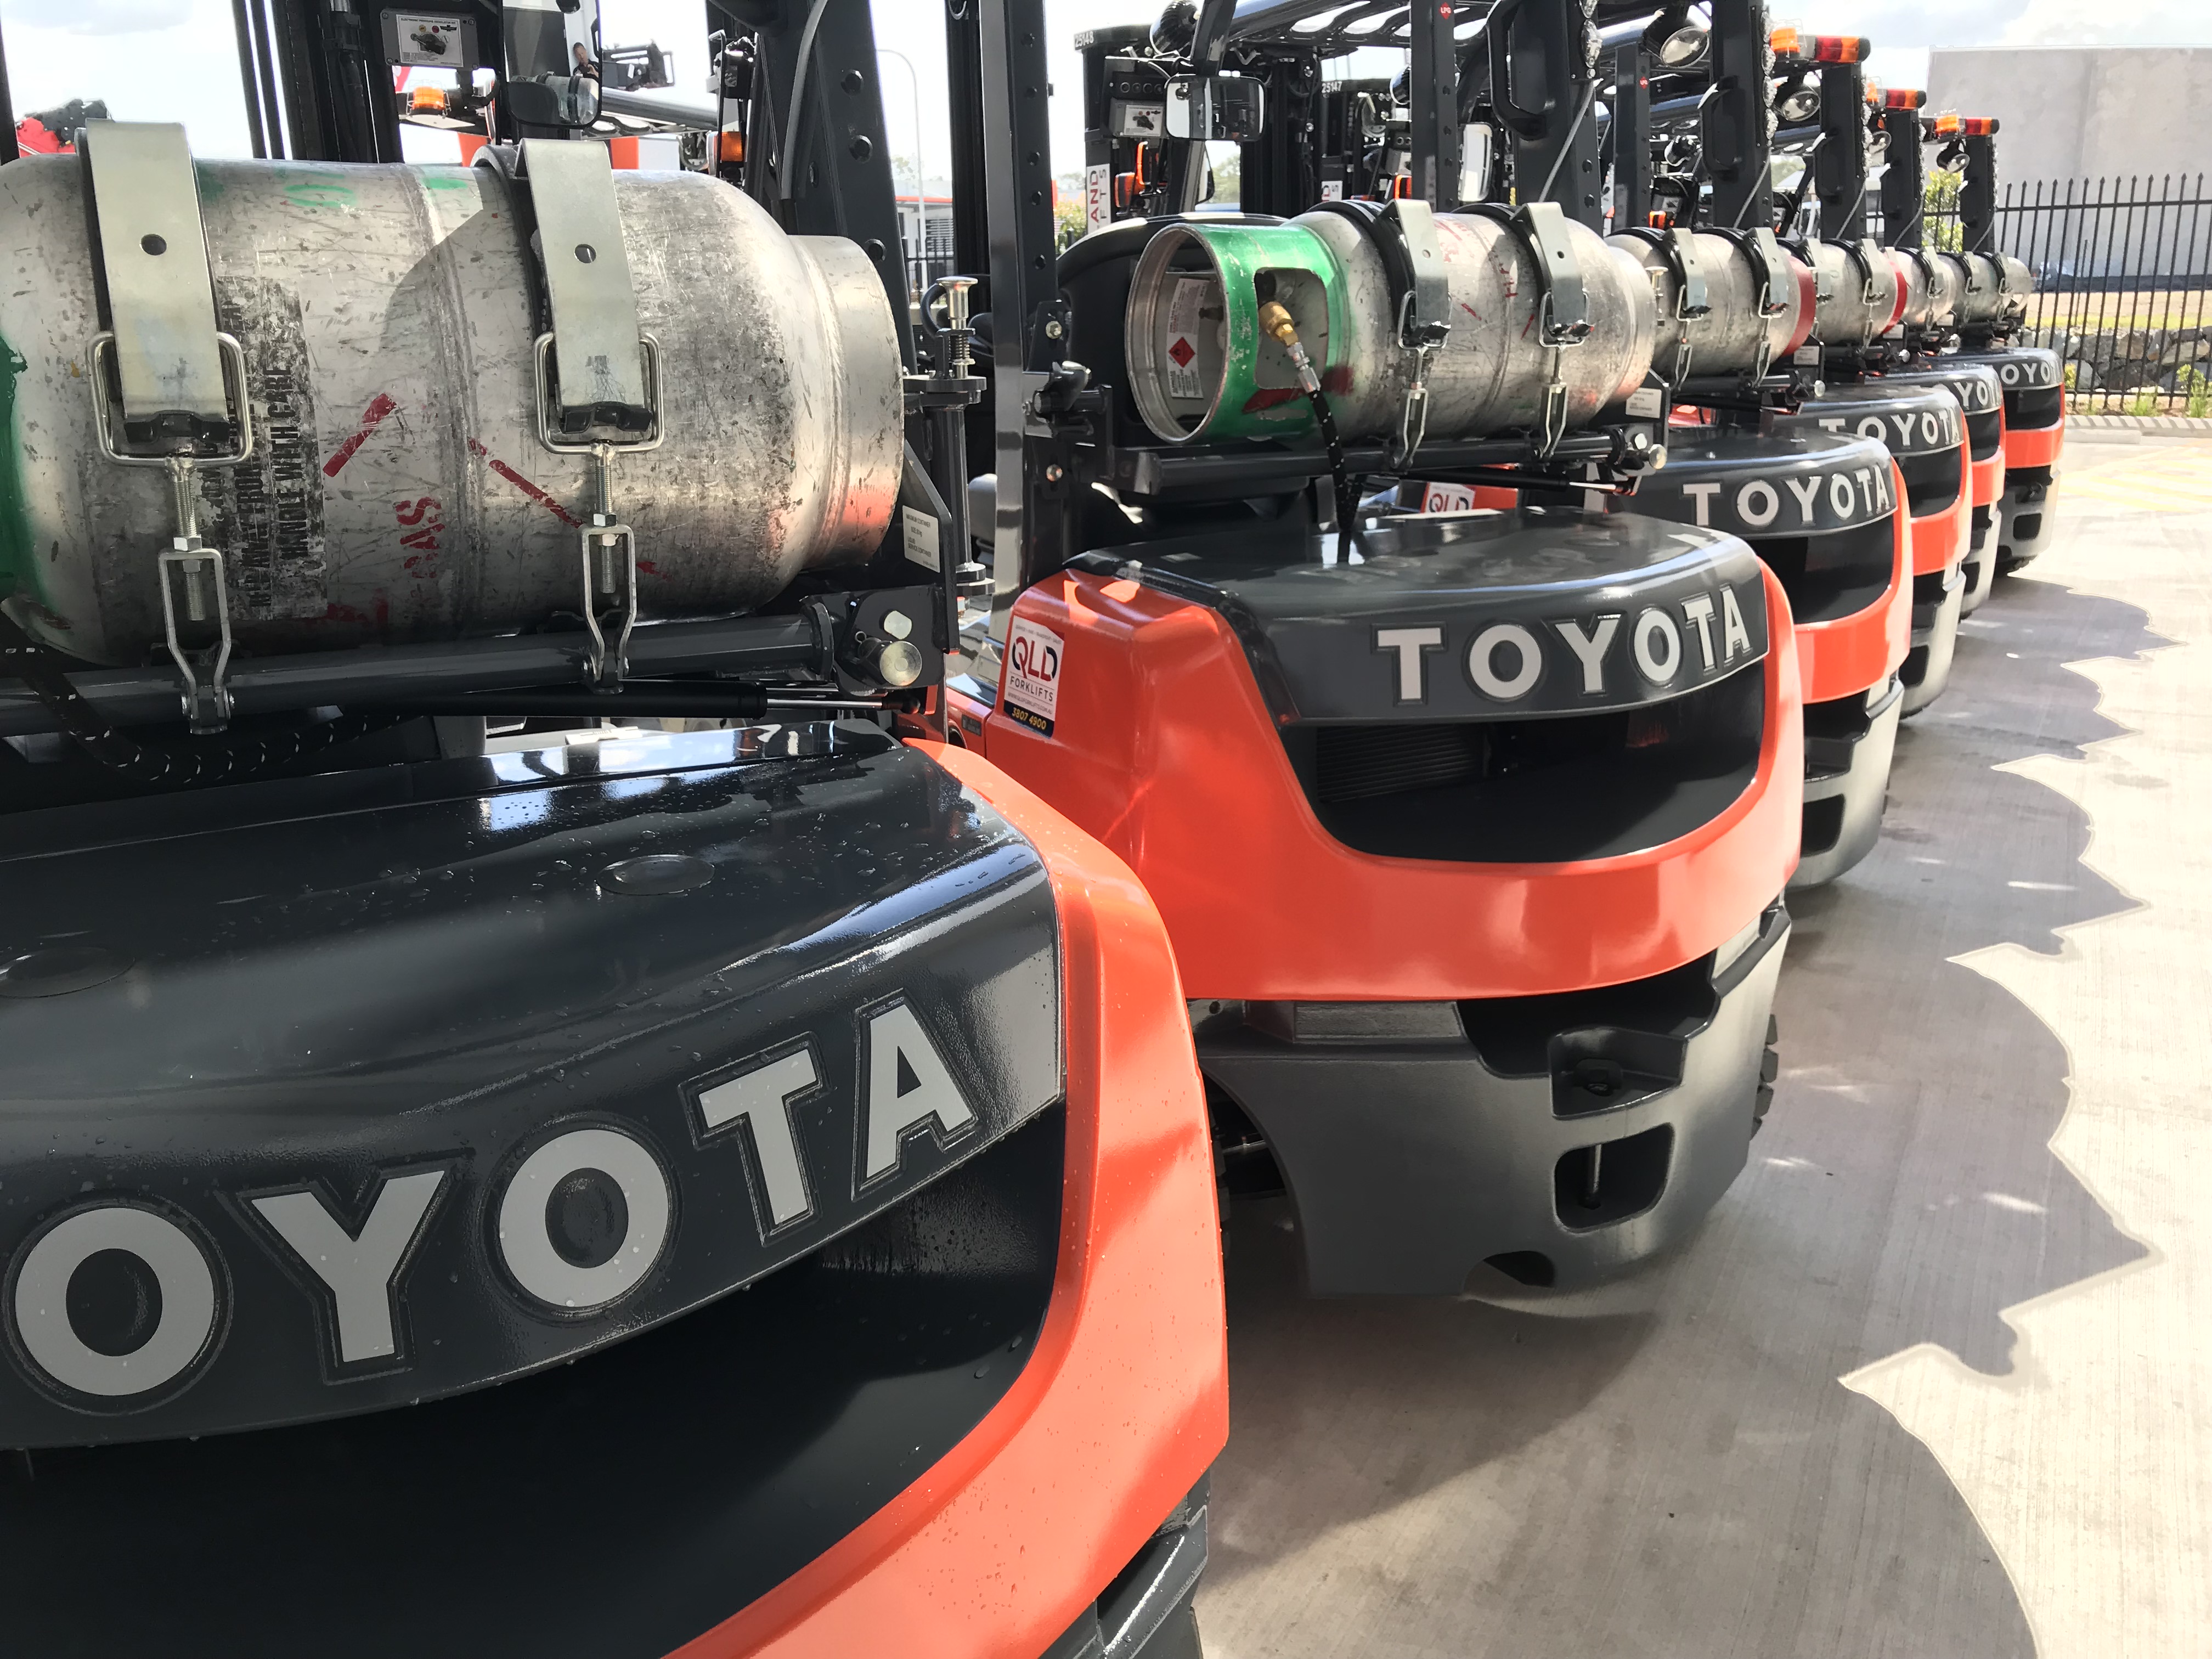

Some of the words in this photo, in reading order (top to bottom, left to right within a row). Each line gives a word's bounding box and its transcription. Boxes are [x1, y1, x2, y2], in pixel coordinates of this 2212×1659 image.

[1075, 31, 1094, 48] 25148
[1322, 81, 1342, 93] 25147
[1090, 170, 1099, 229] AND
[263, 363, 296, 419] CARE
[270, 426, 303, 482] WITH
[1682, 464, 1890, 527] TOYOTA
[276, 488, 309, 561] HANDLE
[1012, 636, 1058, 682] QLD
[1376, 585, 1751, 701] TOYOTA
[1009, 676, 1053, 702] FORKLIFTS
[1012, 707, 1029, 721] 3807
[1029, 714, 1047, 730] 4900
[14, 1001, 978, 1397] OYOTA
